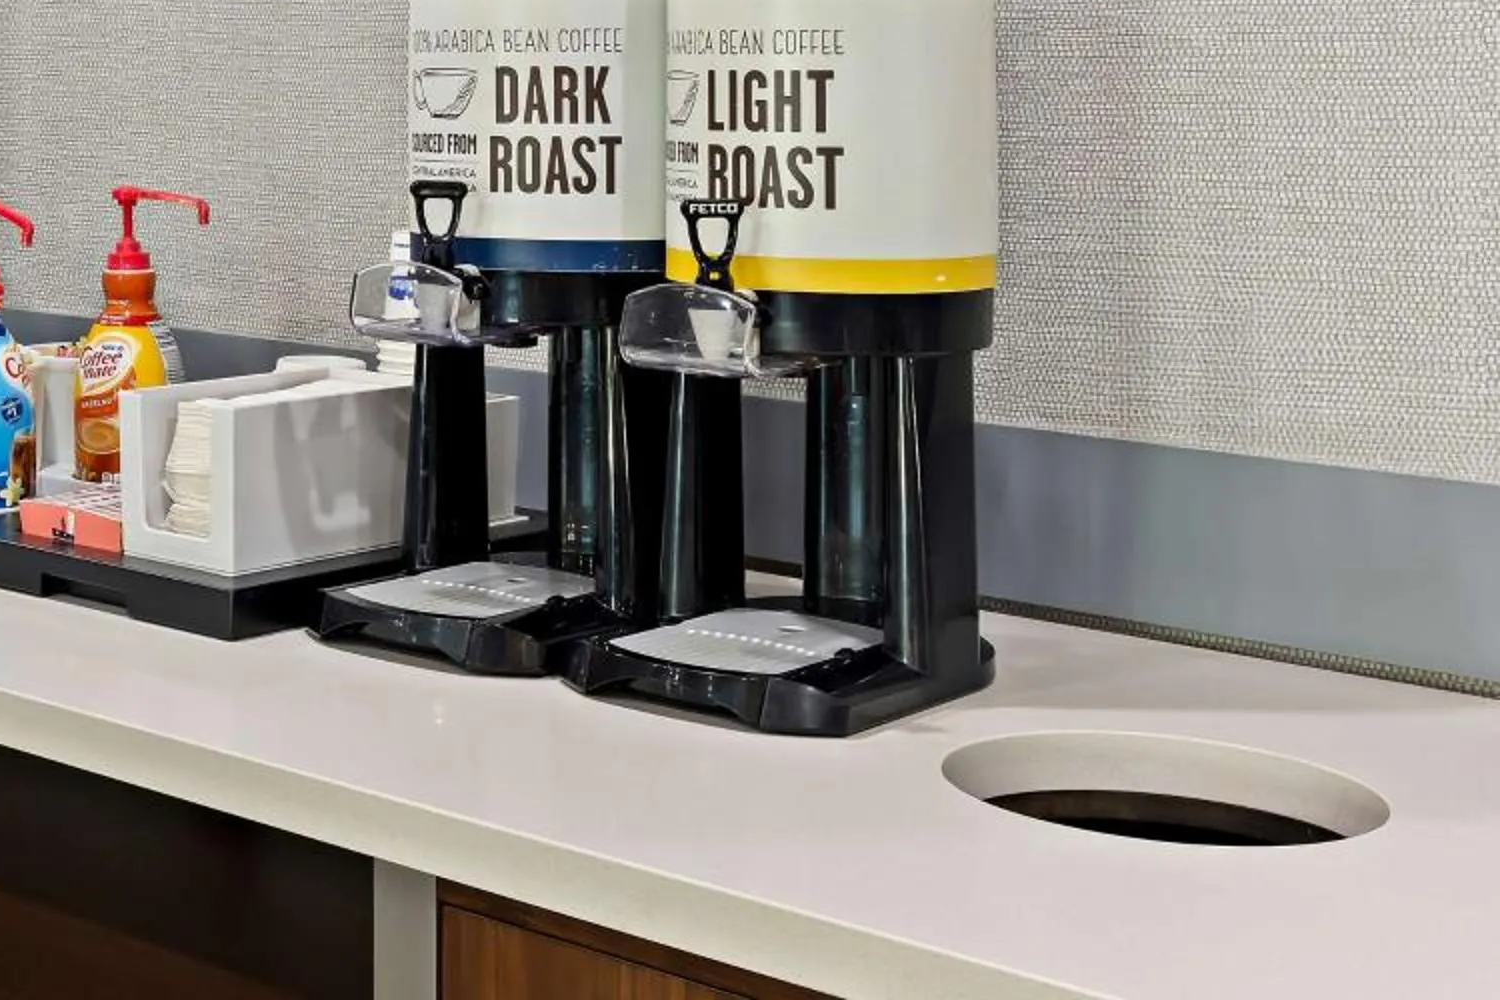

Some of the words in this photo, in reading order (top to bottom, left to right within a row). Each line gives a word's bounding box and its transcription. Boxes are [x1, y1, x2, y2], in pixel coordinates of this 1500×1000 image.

[503, 28, 549, 53] BEAN
[558, 28, 623, 53] COFFEE
[719, 29, 764, 55] BEAN
[773, 29, 845, 55] COFFEE
[495, 65, 612, 125] DARK
[707, 69, 835, 133] LIGHT
[447, 133, 477, 155] FROM
[489, 135, 623, 194] ROAST
[707, 144, 845, 210] ROAST
[689, 203, 739, 214] FETCO
[79, 345, 123, 369] Coffee
